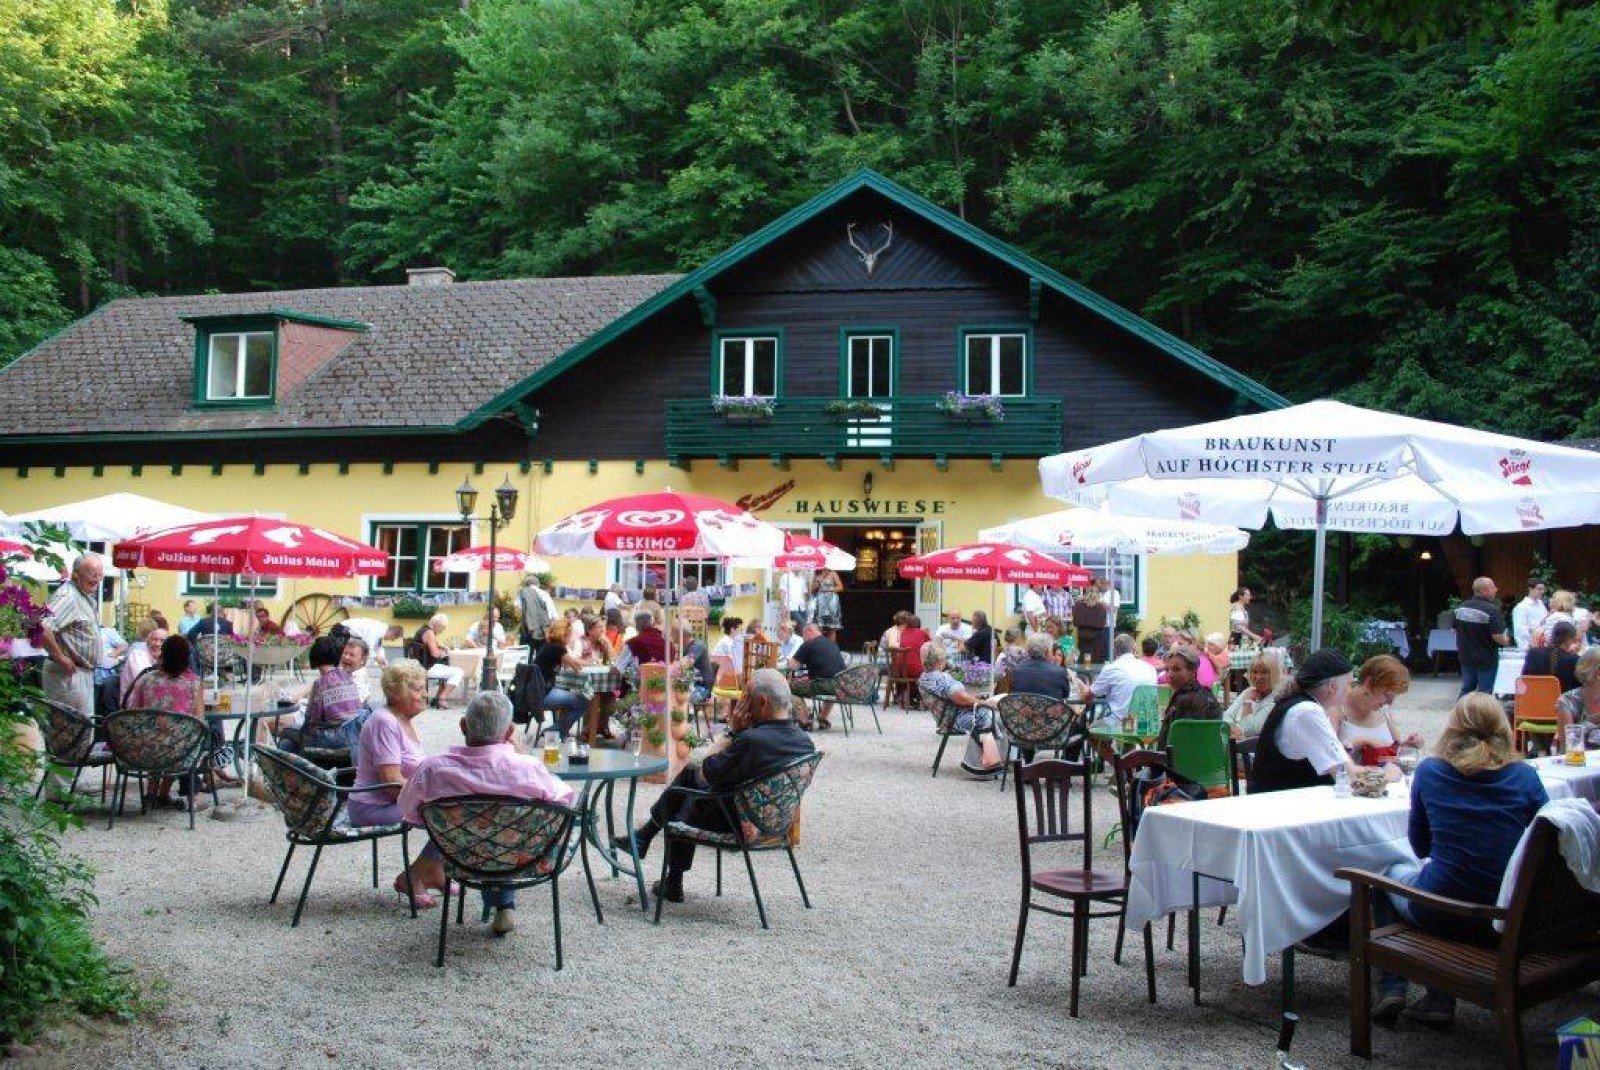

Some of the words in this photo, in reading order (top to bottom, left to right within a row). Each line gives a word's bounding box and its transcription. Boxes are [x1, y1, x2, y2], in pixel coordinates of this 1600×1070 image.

[1205, 436, 1337, 454] BRAUKUNST
[1155, 458, 1191, 475] AUF
[1198, 455, 1314, 475] HÖCHSTER
[1320, 459, 1390, 475] STUFE
[616, 535, 677, 550] ESKIMO
[157, 551, 198, 564] Julius
[200, 553, 235, 566] Meinl
[262, 553, 303, 566] Julius
[305, 555, 340, 568] Meinl
